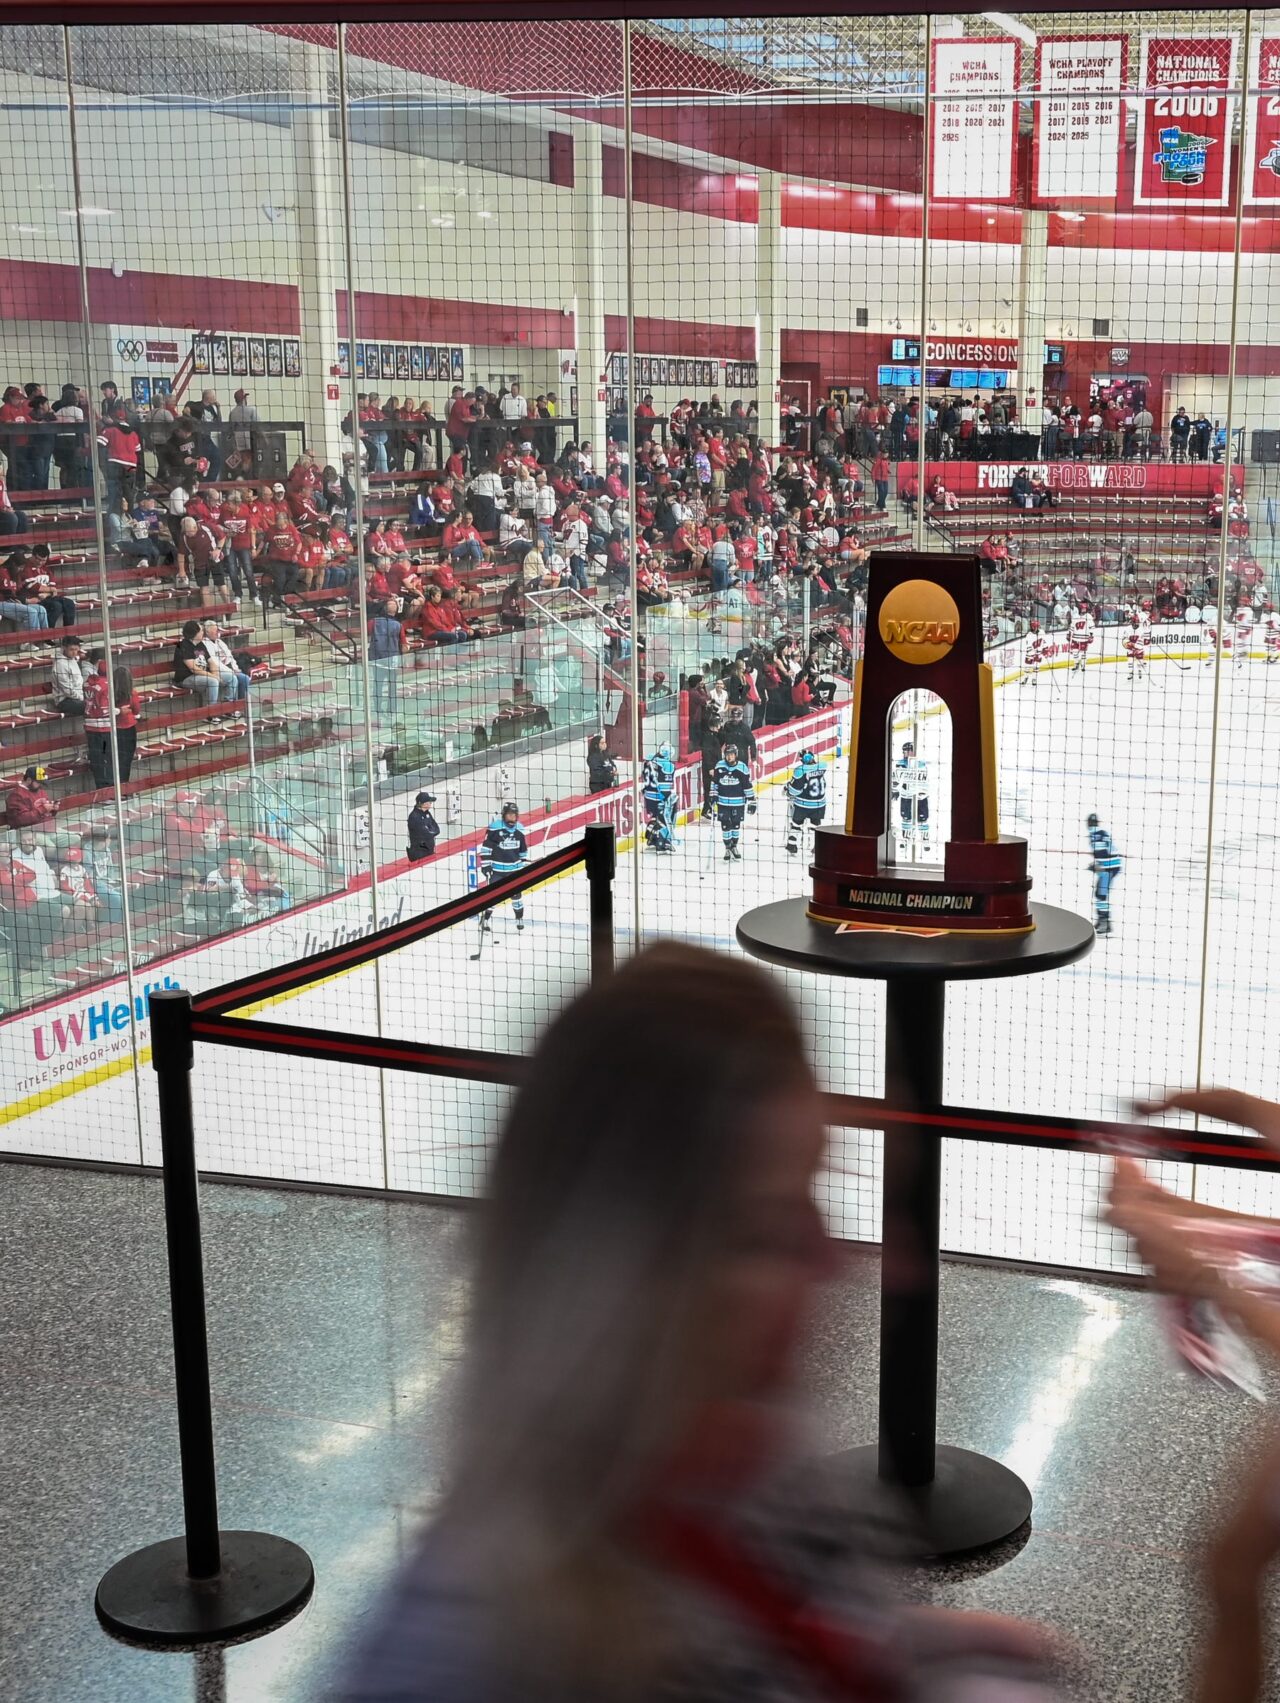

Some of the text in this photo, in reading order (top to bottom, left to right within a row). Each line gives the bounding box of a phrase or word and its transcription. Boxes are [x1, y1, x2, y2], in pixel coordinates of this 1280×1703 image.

[962, 60, 987, 70] WCHA
[1049, 57, 1114, 68] WCHA PLAYOFF
[1156, 55, 1220, 70] NATIONAL
[950, 72, 999, 83] CHAMPIONS
[1056, 69, 1105, 80] CHAMPIONS
[1156, 69, 1220, 81] CHAMPIONS
[1048, 102, 1066, 112] 2011
[1154, 87, 1218, 117] 2006
[1047, 117, 1066, 127] 2017
[884, 619, 957, 644] NCAA
[1151, 634, 1200, 645] oin139.com
[849, 888, 973, 910] NATIONAL CHAMPION
[17, 1073, 48, 1092] TITLE
